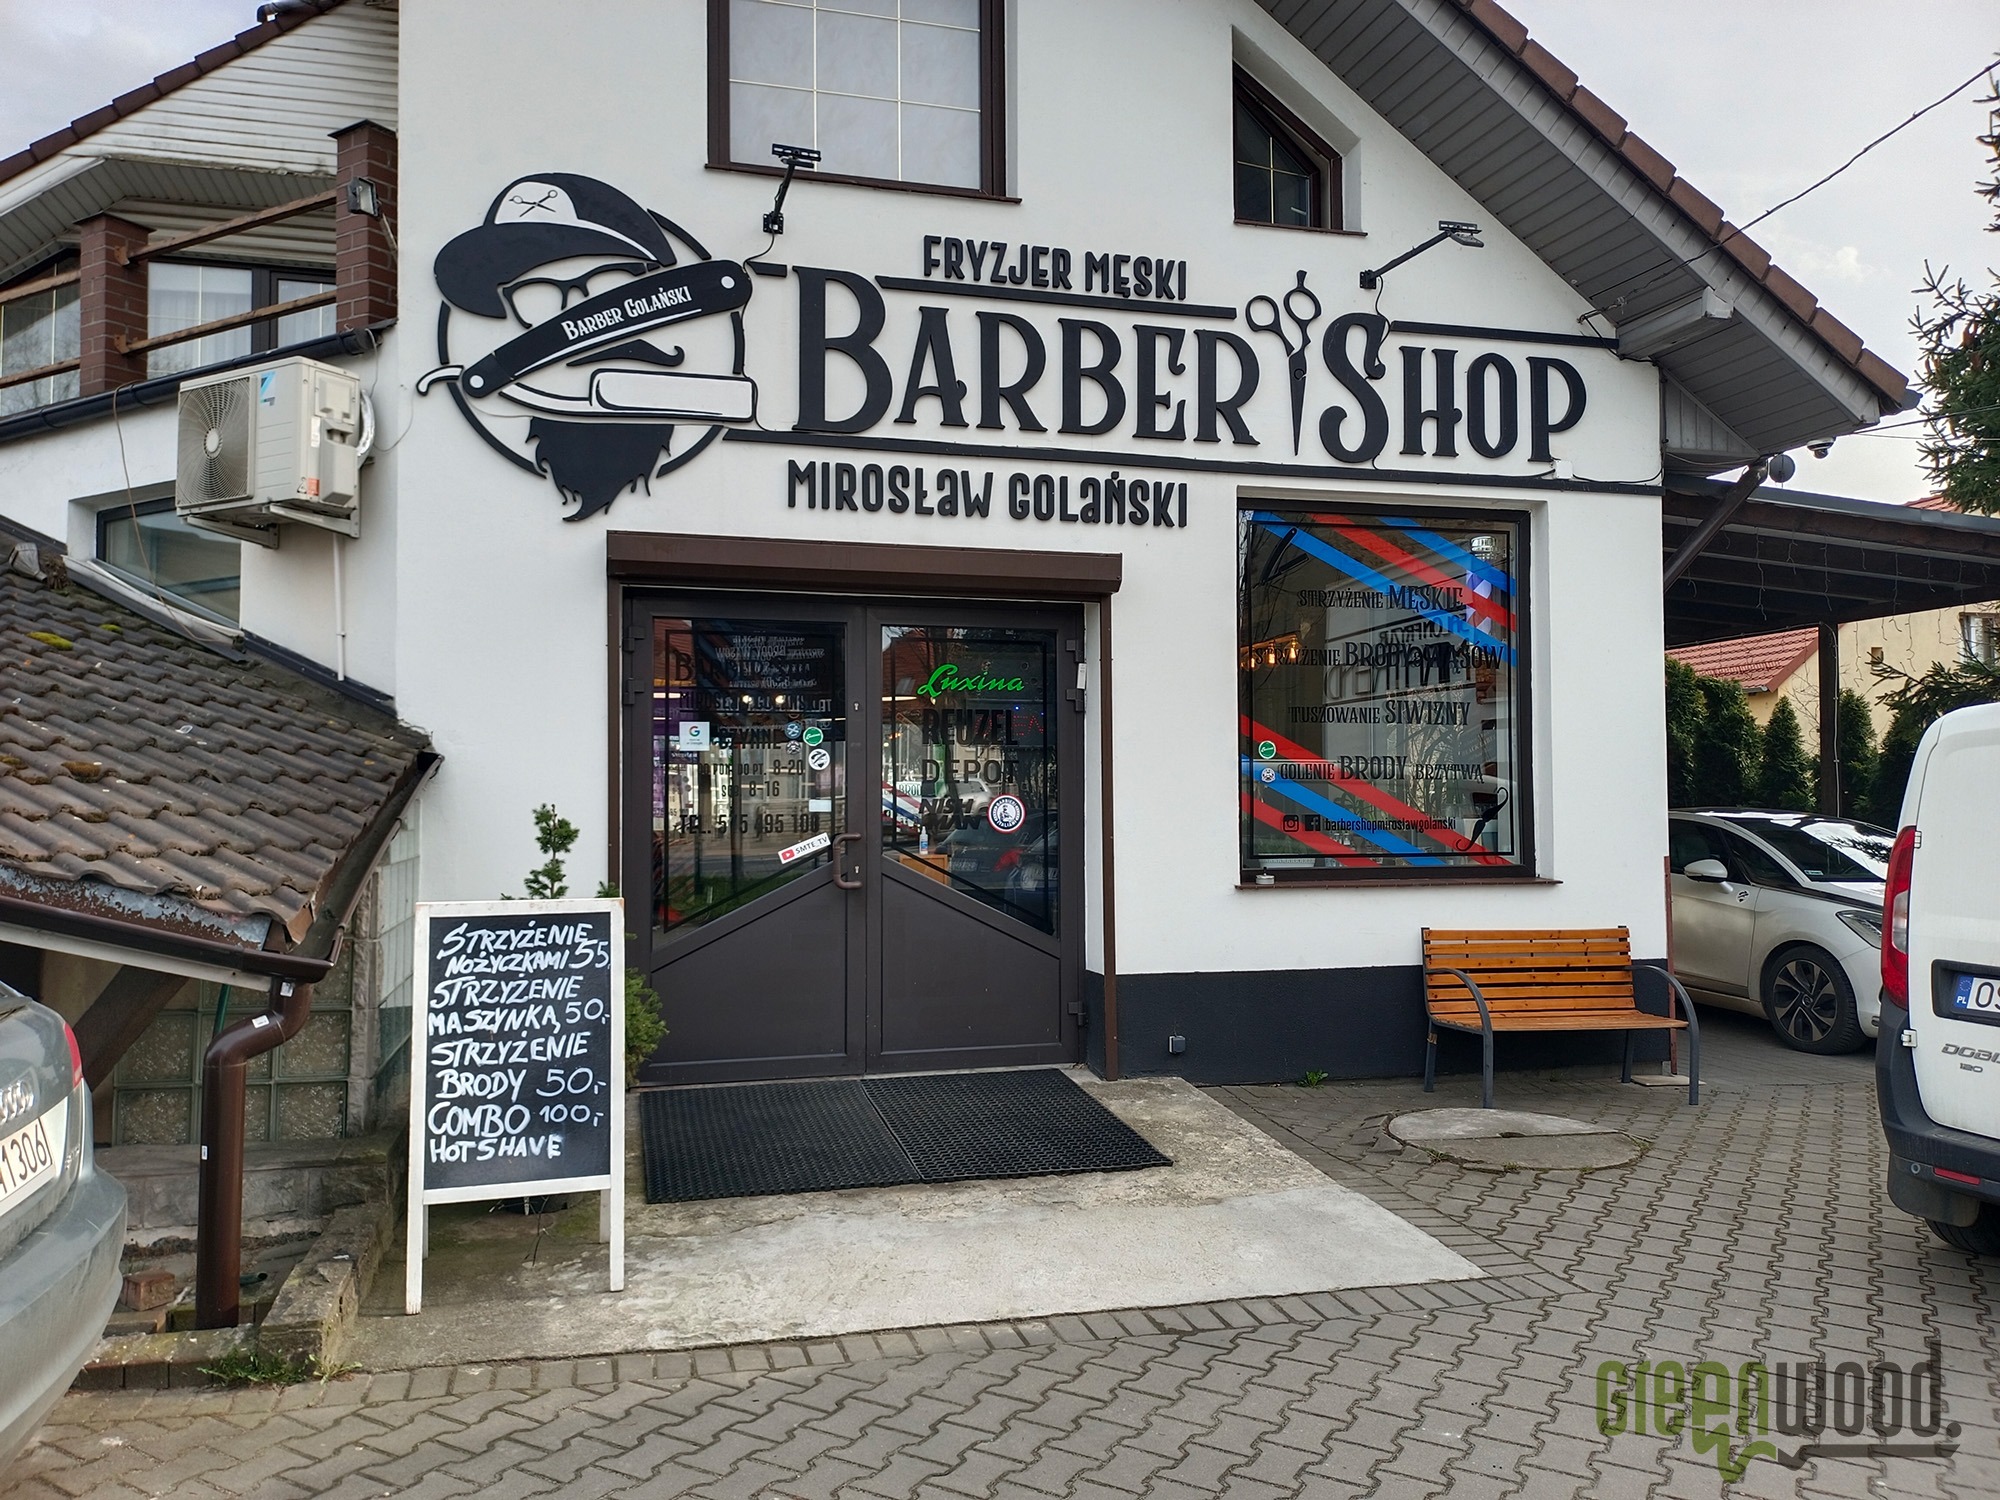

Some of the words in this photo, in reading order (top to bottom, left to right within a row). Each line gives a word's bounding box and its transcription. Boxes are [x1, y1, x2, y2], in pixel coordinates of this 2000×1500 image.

[923, 234, 1072, 290] FRYZJER
[1085, 250, 1187, 300] MĘSKI
[561, 307, 625, 340] BARBER
[624, 285, 692, 318] GOLAŃSKI
[792, 265, 1260, 446] BARBER
[1319, 312, 1587, 464] SHOP
[1297, 587, 1384, 608] STRZYŻENIE
[1389, 584, 1464, 613] MĘSKIE
[1254, 646, 1340, 666] STRZYŻENIE
[1345, 641, 1411, 667] BRODY
[917, 663, 1025, 698] Luxina
[922, 708, 1018, 747] REUZEL
[1289, 706, 1380, 724] TUSZOWANIE
[1385, 700, 1470, 725] SIWIZNY
[773, 759, 803, 775] 8-20
[921, 759, 1019, 784] DEPOT
[1280, 763, 1335, 780] GOLENIE
[1340, 755, 1407, 780] BRODY
[1415, 763, 1485, 784] BRZYTWĄ
[749, 780, 780, 797] 8-16
[437, 920, 593, 960] STRZYŻENIE
[445, 950, 569, 978] NOŻYCZKAMI
[430, 973, 584, 1009] STRZYŻENIE
[1957, 995, 1967, 1004] PL
[428, 1004, 561, 1036] MASZYNKĄ
[431, 1030, 591, 1067] STRZYŻENIE
[1960, 1062, 1983, 1073] 120
[435, 1069, 527, 1102] BRODY
[427, 1101, 531, 1138] COMBO
